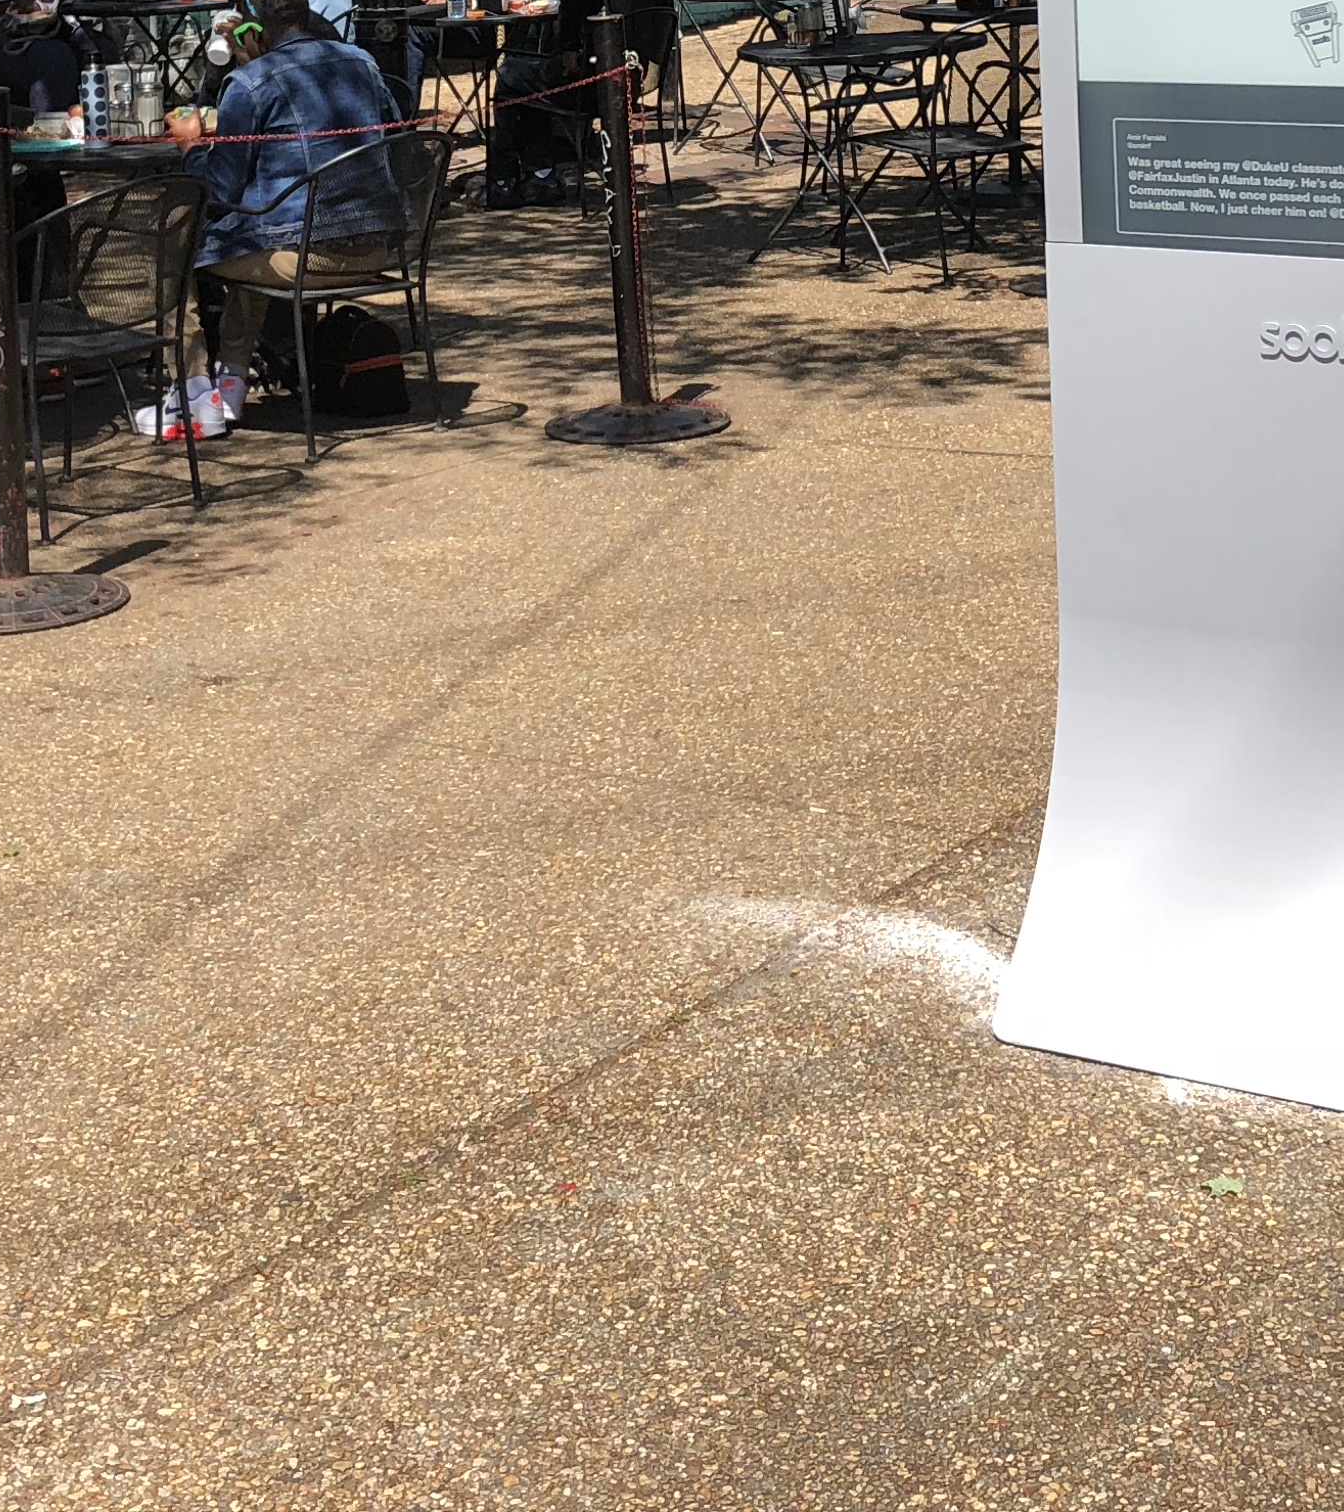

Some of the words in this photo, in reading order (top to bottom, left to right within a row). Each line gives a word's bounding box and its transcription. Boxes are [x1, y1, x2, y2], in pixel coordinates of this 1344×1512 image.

[1128, 156, 1151, 168] Was
[1153, 158, 1182, 171] great
[1184, 160, 1221, 172] seeing
[1223, 163, 1240, 172] my
[1242, 160, 1289, 172] @DukeU
[1129, 171, 1206, 184] @FairfaxJustin
[1209, 174, 1219, 184] in
[1221, 174, 1261, 186] Atlanta
[1263, 175, 1298, 189] today.
[1301, 177, 1326, 189] He's
[1129, 185, 1216, 199] Commonwealth.
[1218, 189, 1237, 199] We
[1239, 192, 1267, 201] once
[1269, 191, 1311, 203] passed
[1312, 194, 1341, 204] each
[1129, 199, 1188, 212] basketball.
[1190, 202, 1219, 214] Now,
[1227, 204, 1248, 216] just
[1251, 205, 1283, 216] cheer
[1285, 207, 1306, 217] him
